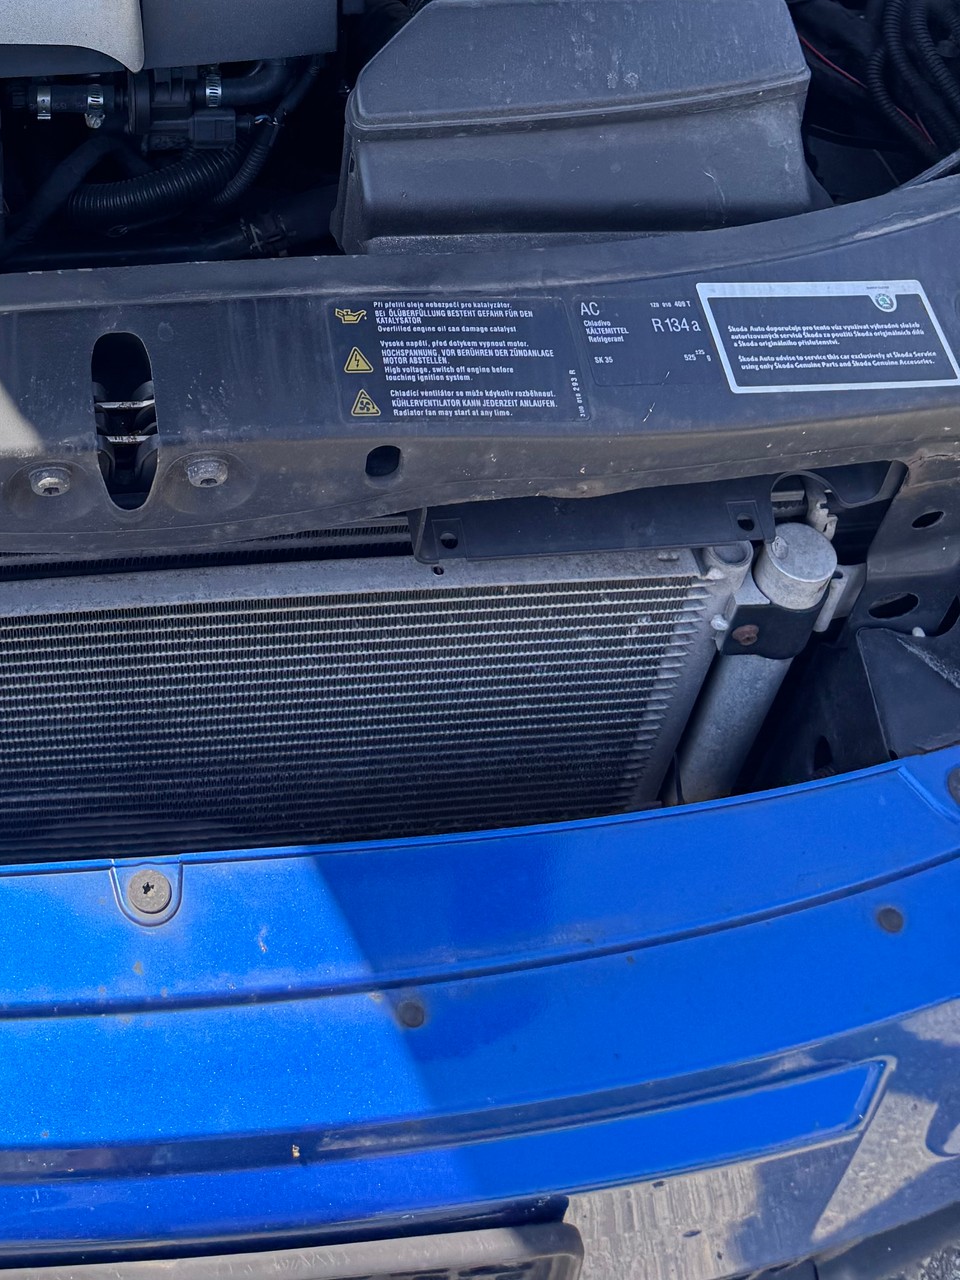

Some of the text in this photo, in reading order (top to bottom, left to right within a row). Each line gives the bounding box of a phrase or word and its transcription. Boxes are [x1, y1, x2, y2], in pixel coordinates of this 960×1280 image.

[388, 308, 446, 317] ÖLÜBERFÜLLUNG
[446, 309, 477, 317] BESTEHT
[505, 309, 519, 317] FÜR
[519, 310, 534, 318] DEN
[580, 302, 600, 316] AC
[461, 325, 489, 333] damage
[489, 325, 517, 333] catalyst
[585, 326, 629, 335] KÄLTEMITTEL
[803, 331, 823, 339] Škoda
[380, 340, 404, 348] Vysoké
[448, 340, 478, 348] dotykem
[479, 340, 506, 348] vypnout
[441, 349, 456, 357] VOR
[457, 348, 494, 357] BERÜHREN
[494, 349, 509, 357] DER
[510, 348, 554, 357] ZÜNDANLAGE
[851, 352, 885, 360] exclusively
[409, 356, 450, 364] ABSTELLEN.
[384, 366, 401, 374] High
[466, 366, 490, 374] engine
[386, 374, 473, 382] touching ignition system.
[570, 377, 580, 391] 293
[420, 389, 454, 397] ventilátor
[484, 390, 514, 398] kdykoliv
[392, 398, 558, 408] KÜHLERVENTILATOR KANN JEDERZEIT ANLAUFEN.
